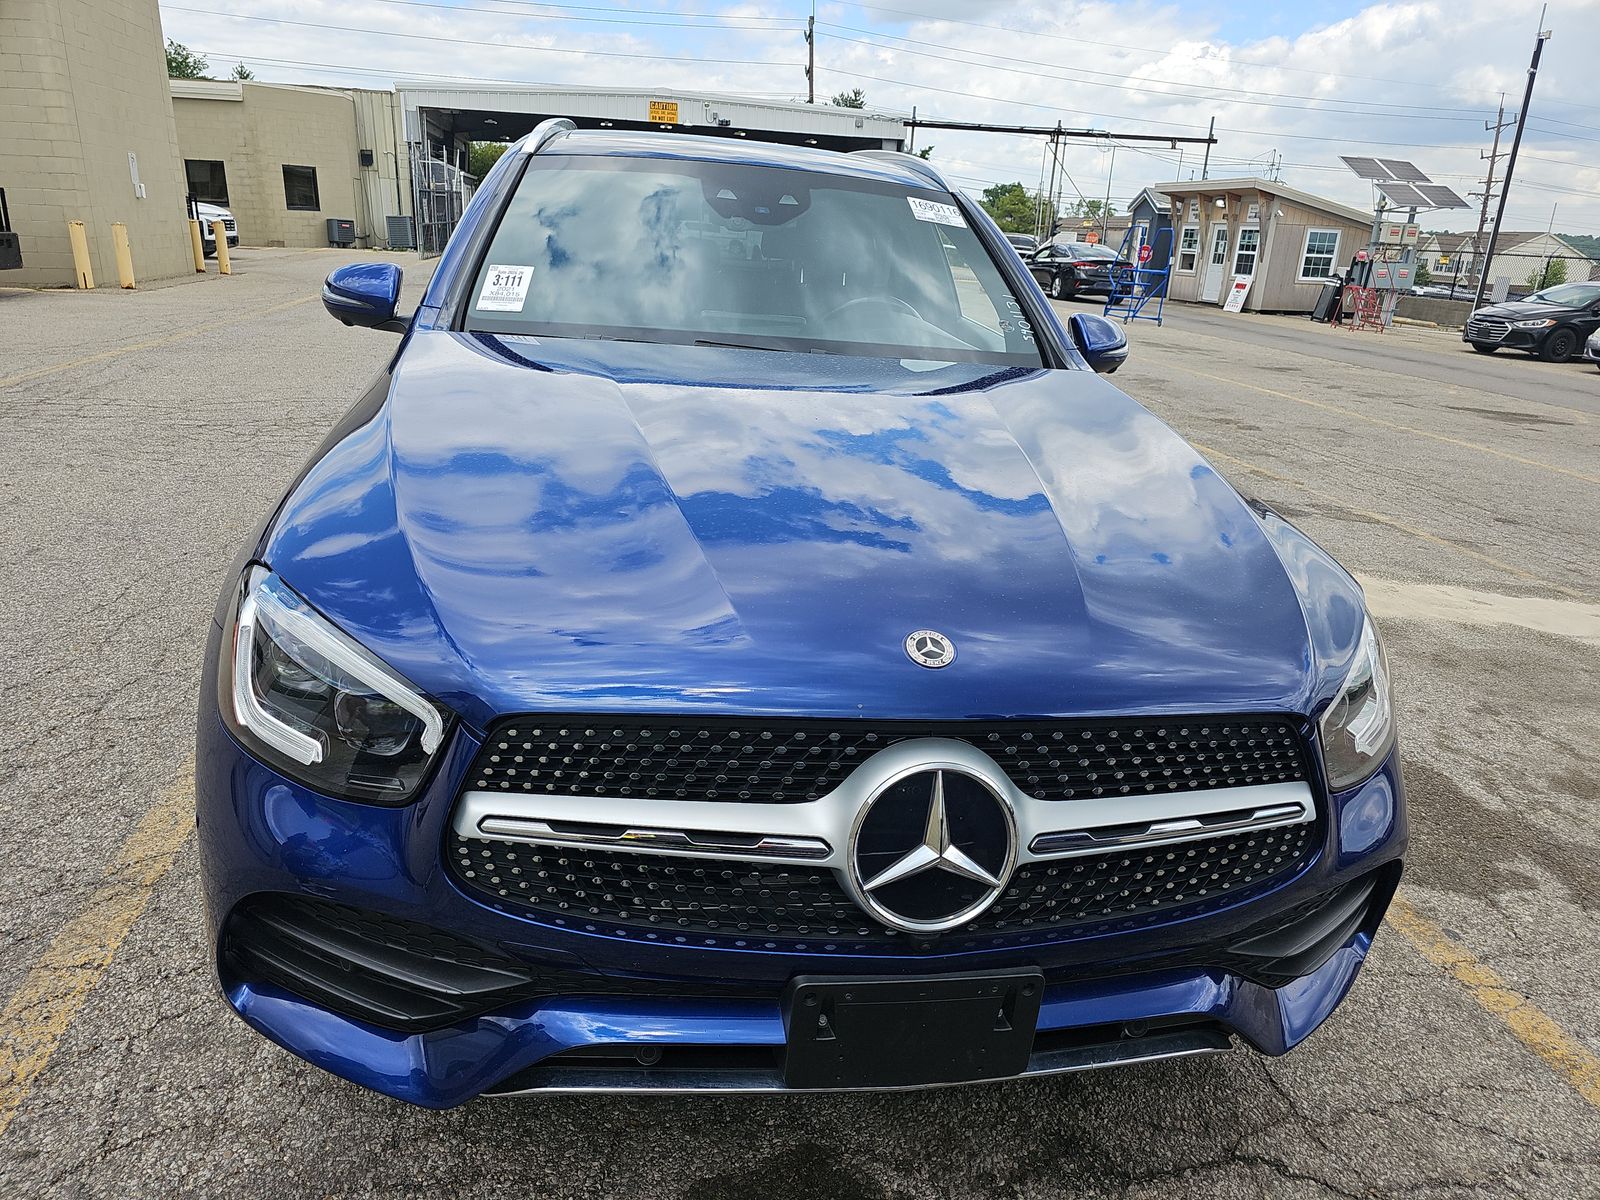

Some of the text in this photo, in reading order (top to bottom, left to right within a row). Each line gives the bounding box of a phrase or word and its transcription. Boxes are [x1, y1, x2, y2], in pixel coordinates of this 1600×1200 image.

[650, 101, 677, 111] CAUTION
[912, 200, 961, 216] 1690116
[493, 274, 522, 287] 3:111
